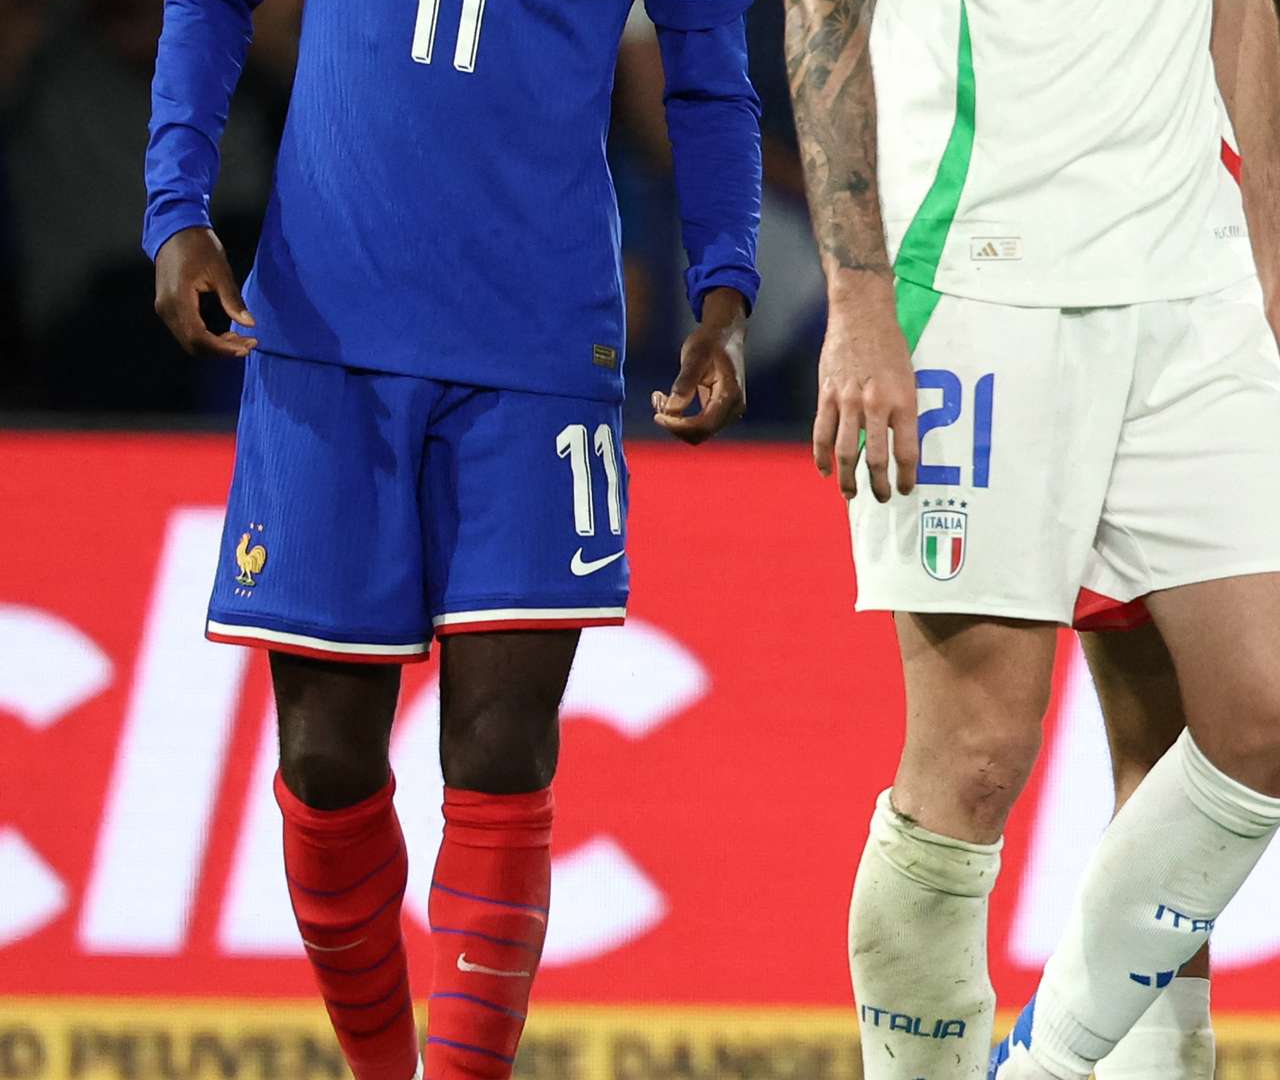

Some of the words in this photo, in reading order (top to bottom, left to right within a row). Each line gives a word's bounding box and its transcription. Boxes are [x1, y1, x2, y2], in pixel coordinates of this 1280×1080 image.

[914, 369, 995, 488] 21
[556, 424, 621, 536] 11
[925, 516, 963, 530] ITALIA
[861, 1004, 967, 1039] ITALIA
